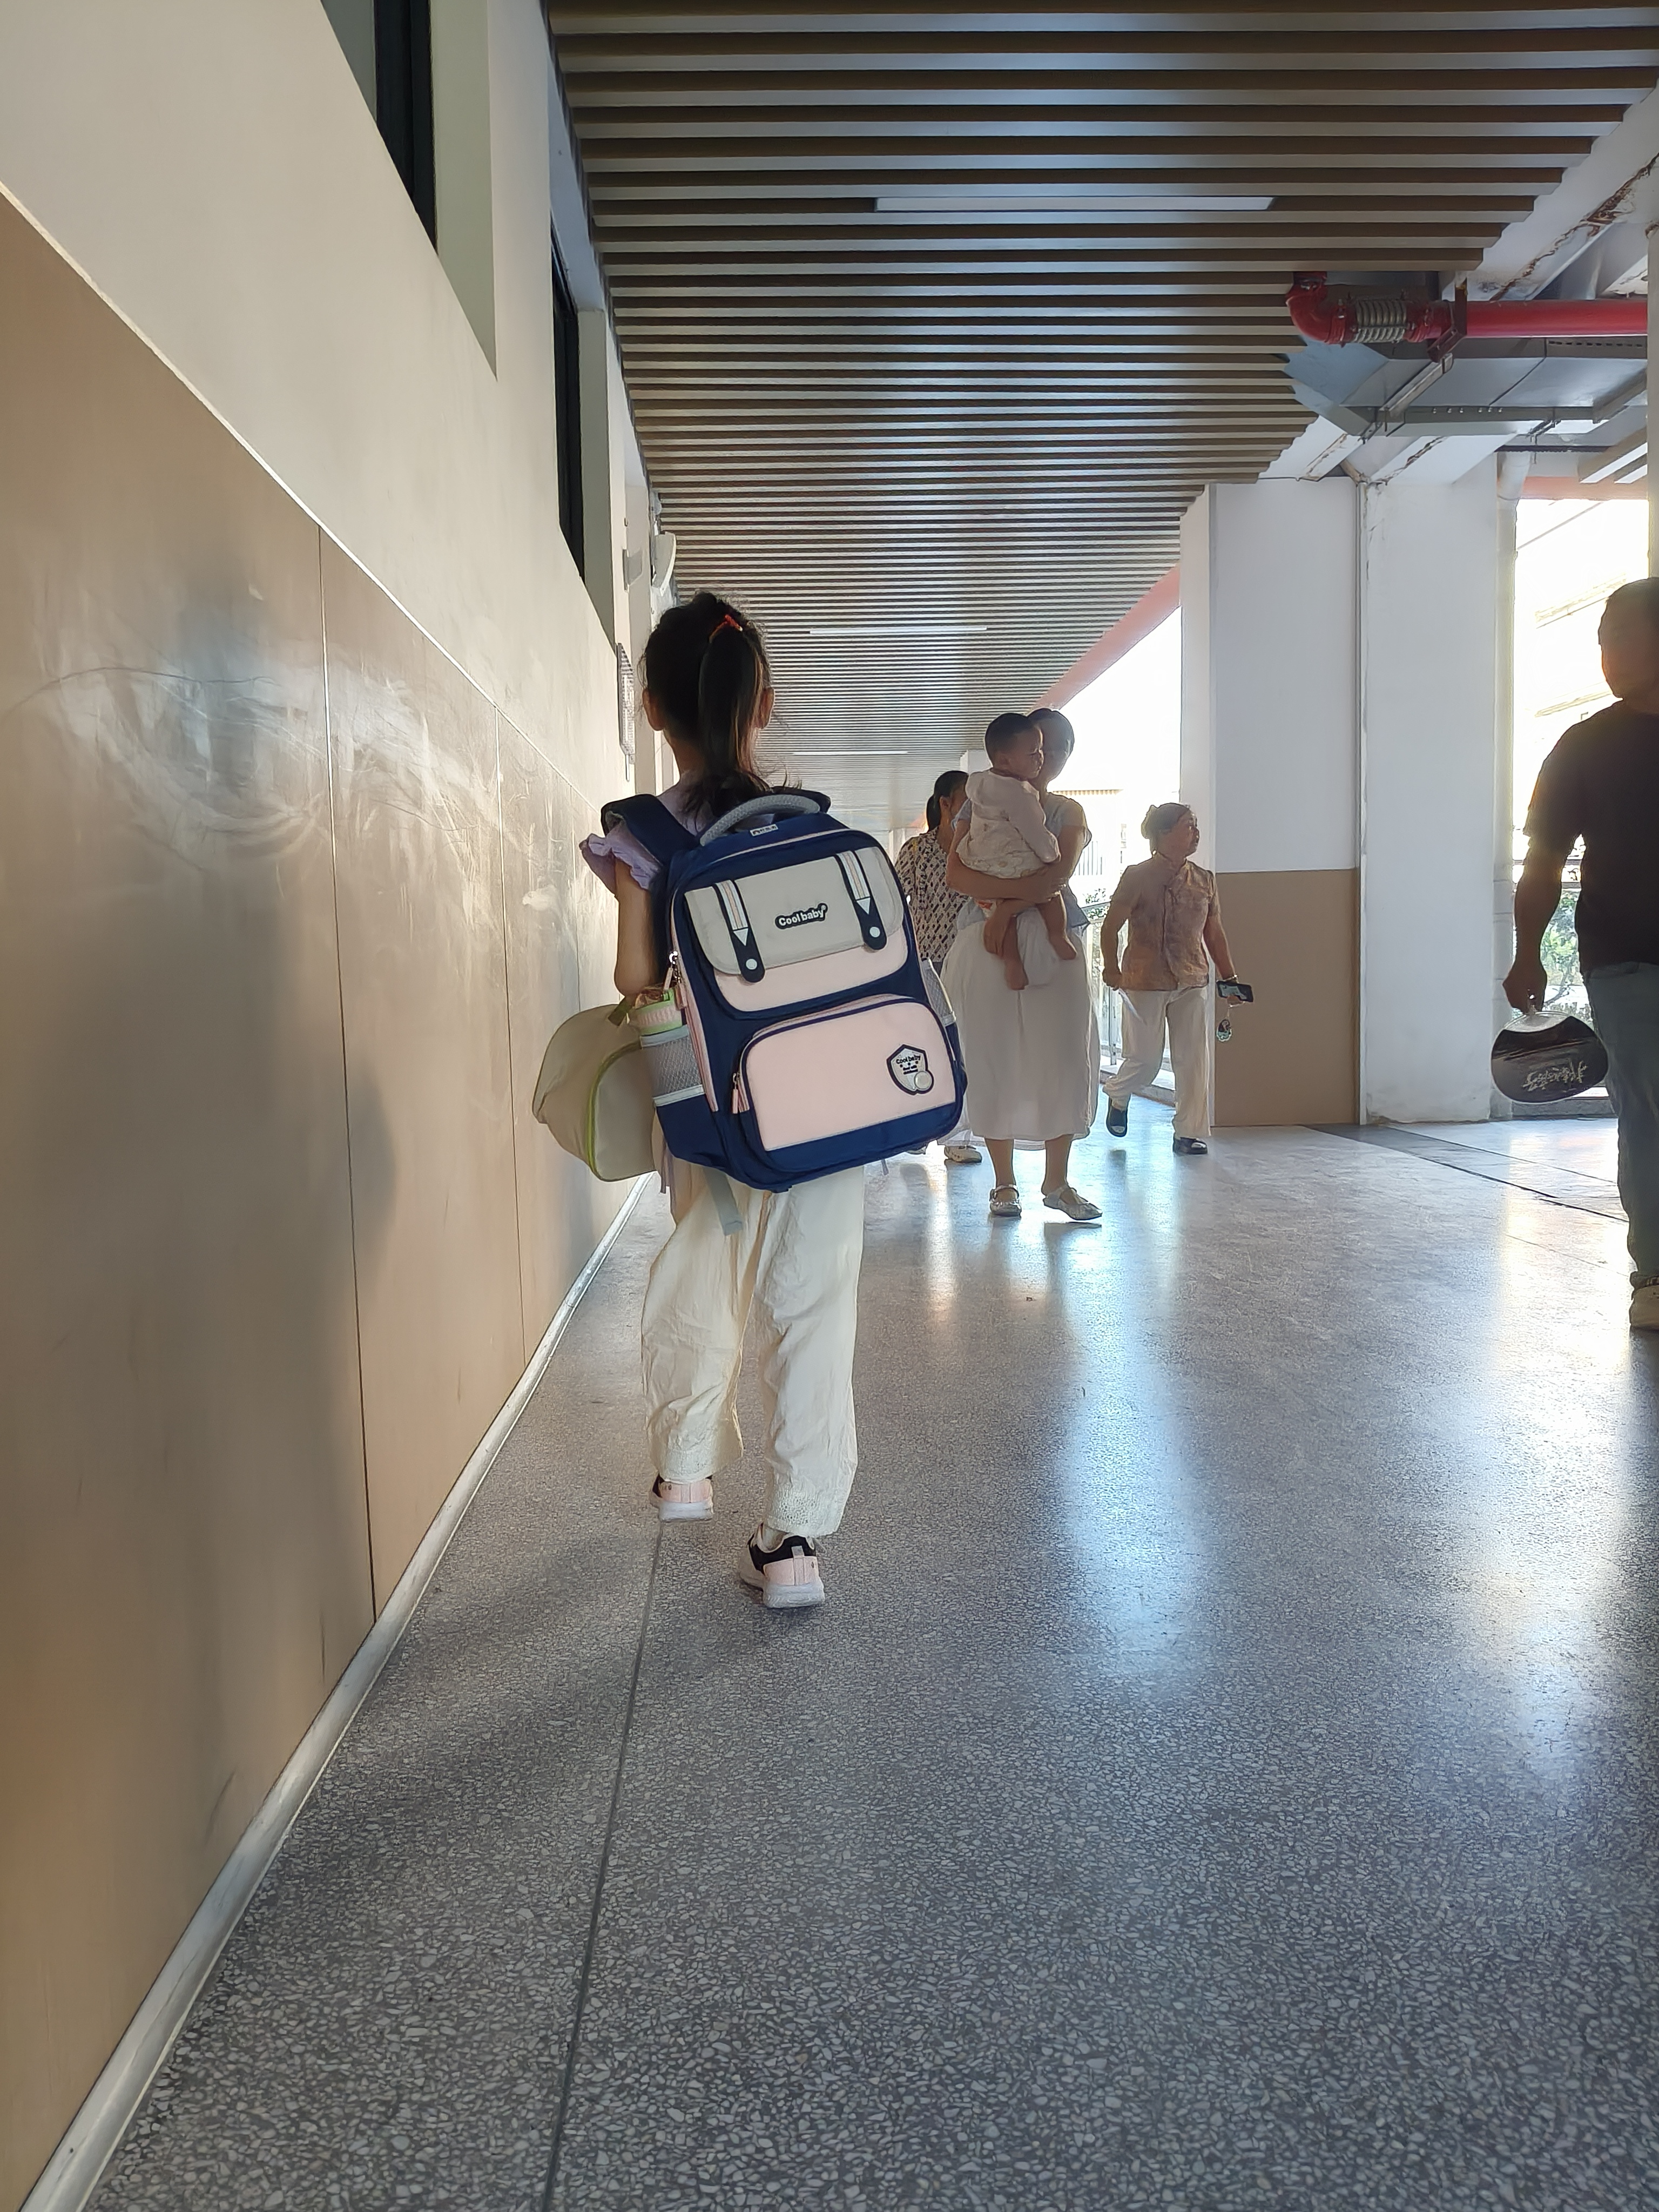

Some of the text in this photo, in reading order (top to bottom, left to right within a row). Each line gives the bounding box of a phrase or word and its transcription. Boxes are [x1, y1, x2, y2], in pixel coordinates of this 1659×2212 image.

[779, 909, 824, 926] Cool baby
[896, 1056, 908, 1064] Cool
